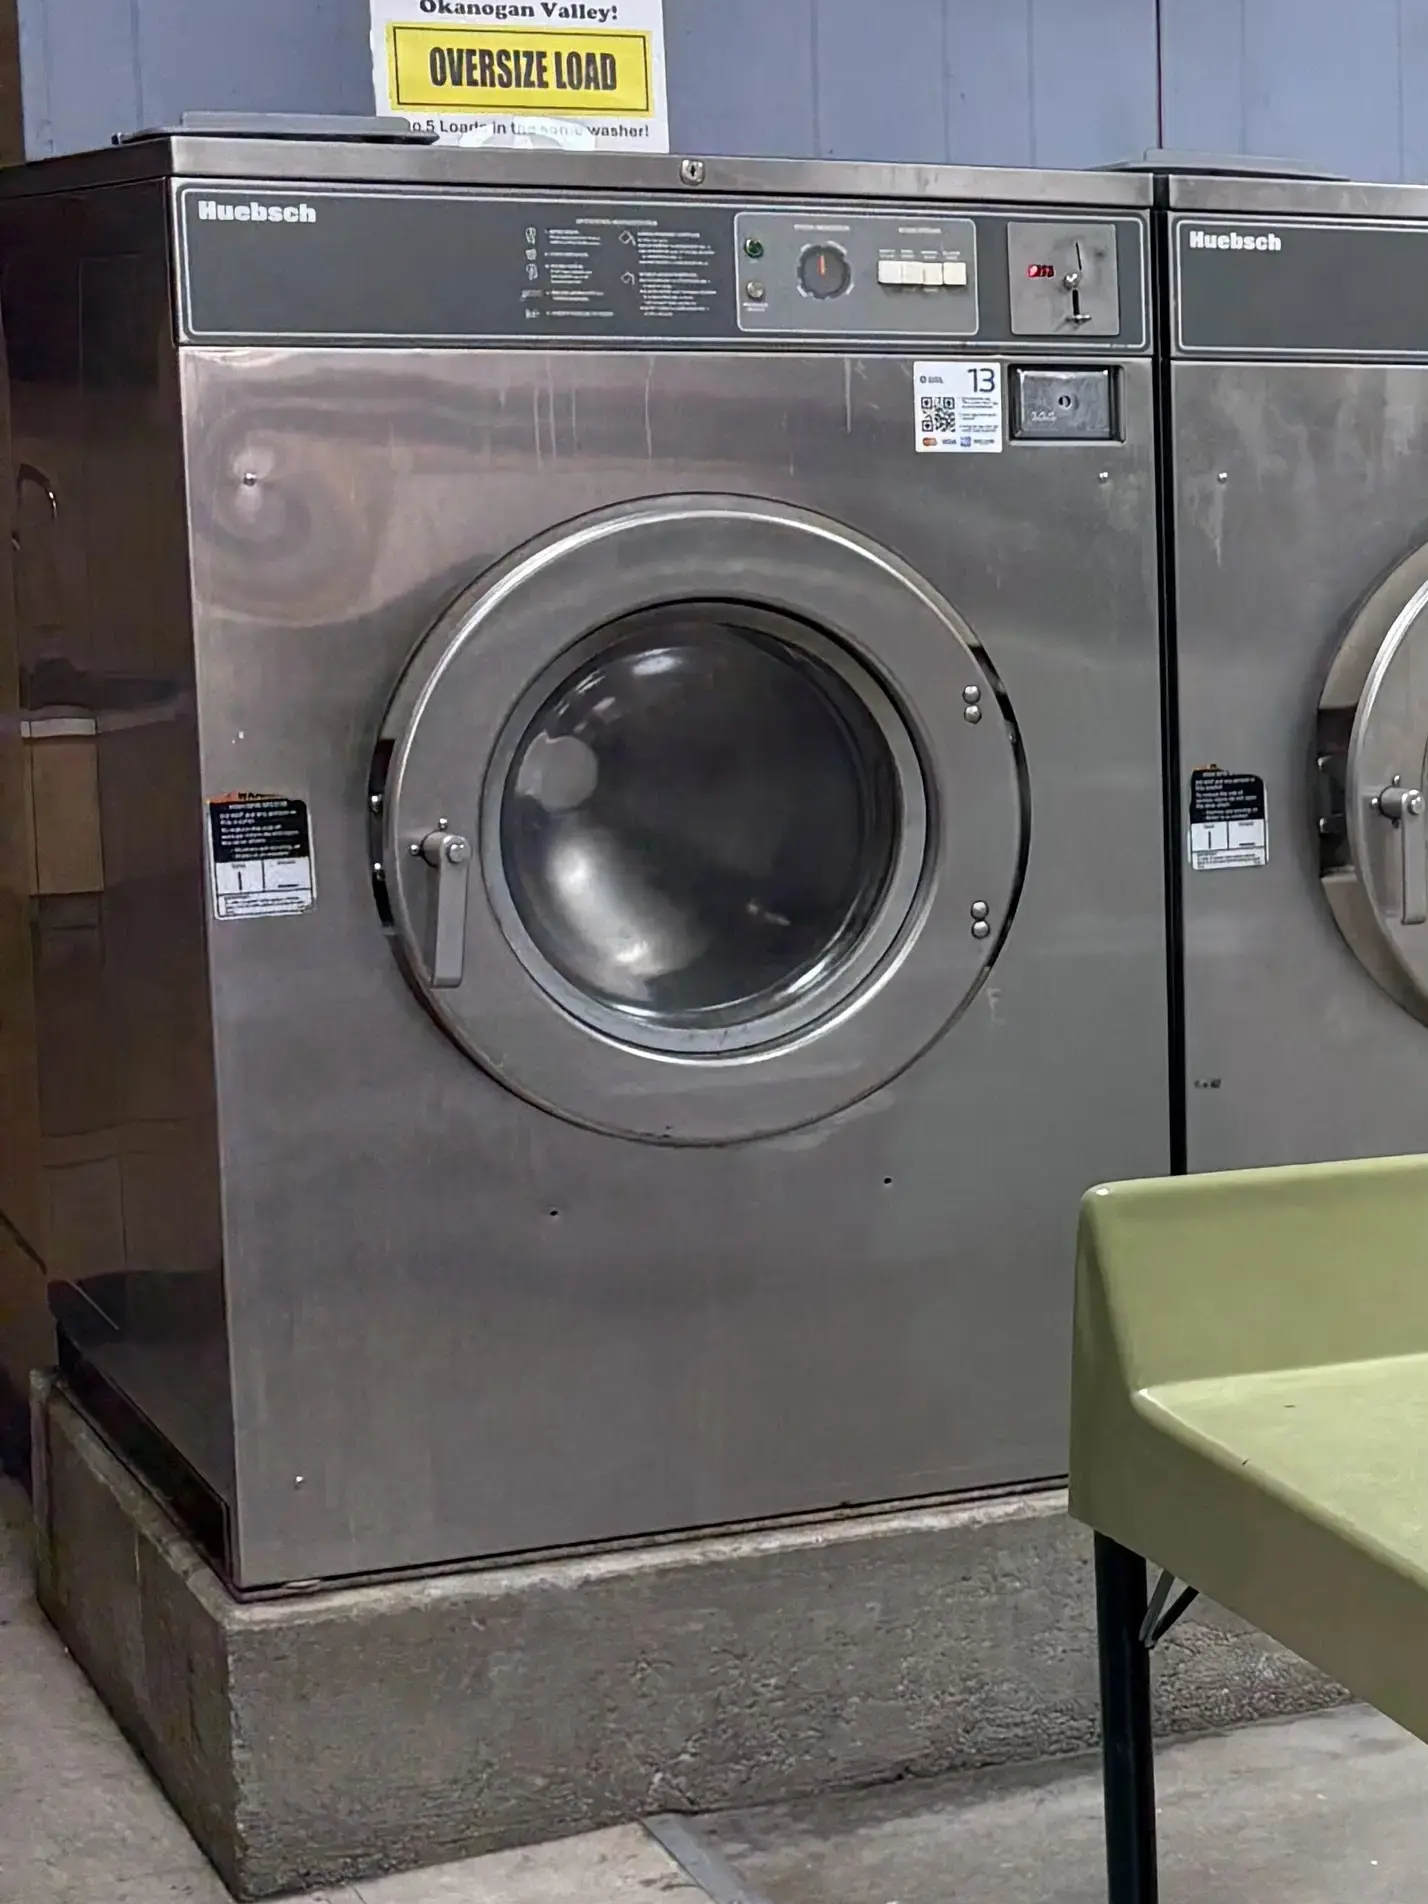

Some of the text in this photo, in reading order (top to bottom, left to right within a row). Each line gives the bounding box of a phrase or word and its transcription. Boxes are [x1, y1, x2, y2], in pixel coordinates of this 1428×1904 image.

[540, 2, 618, 22] Valley!
[429, 46, 617, 91] OVERSIZE LOAD
[198, 200, 316, 223] Huebsch
[1189, 230, 1282, 252] Huebsch
[967, 367, 996, 393] 13
